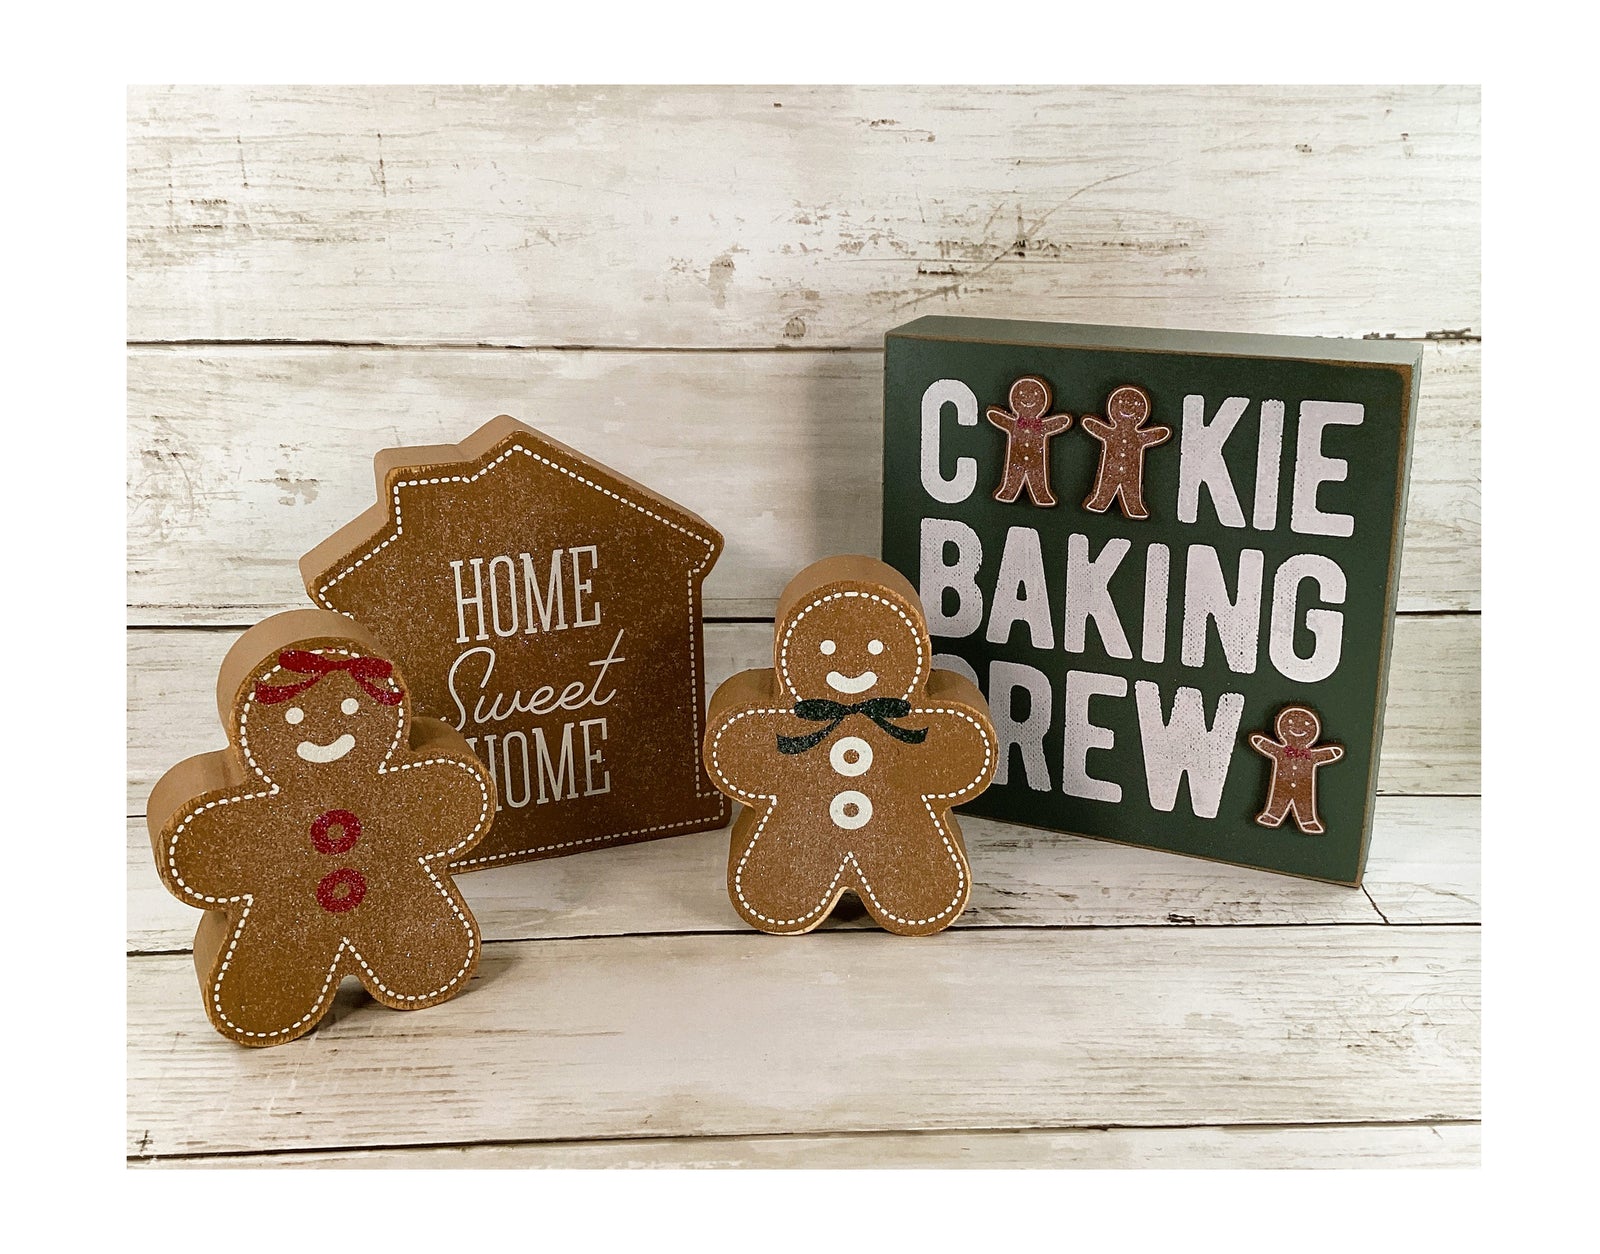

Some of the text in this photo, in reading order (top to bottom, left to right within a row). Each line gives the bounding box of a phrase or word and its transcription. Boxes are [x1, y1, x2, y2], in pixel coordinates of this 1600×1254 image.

[449, 544, 601, 644] HOME
[919, 517, 1347, 684] BAKING
[448, 628, 626, 732] Sweet
[931, 653, 1245, 819] REW
